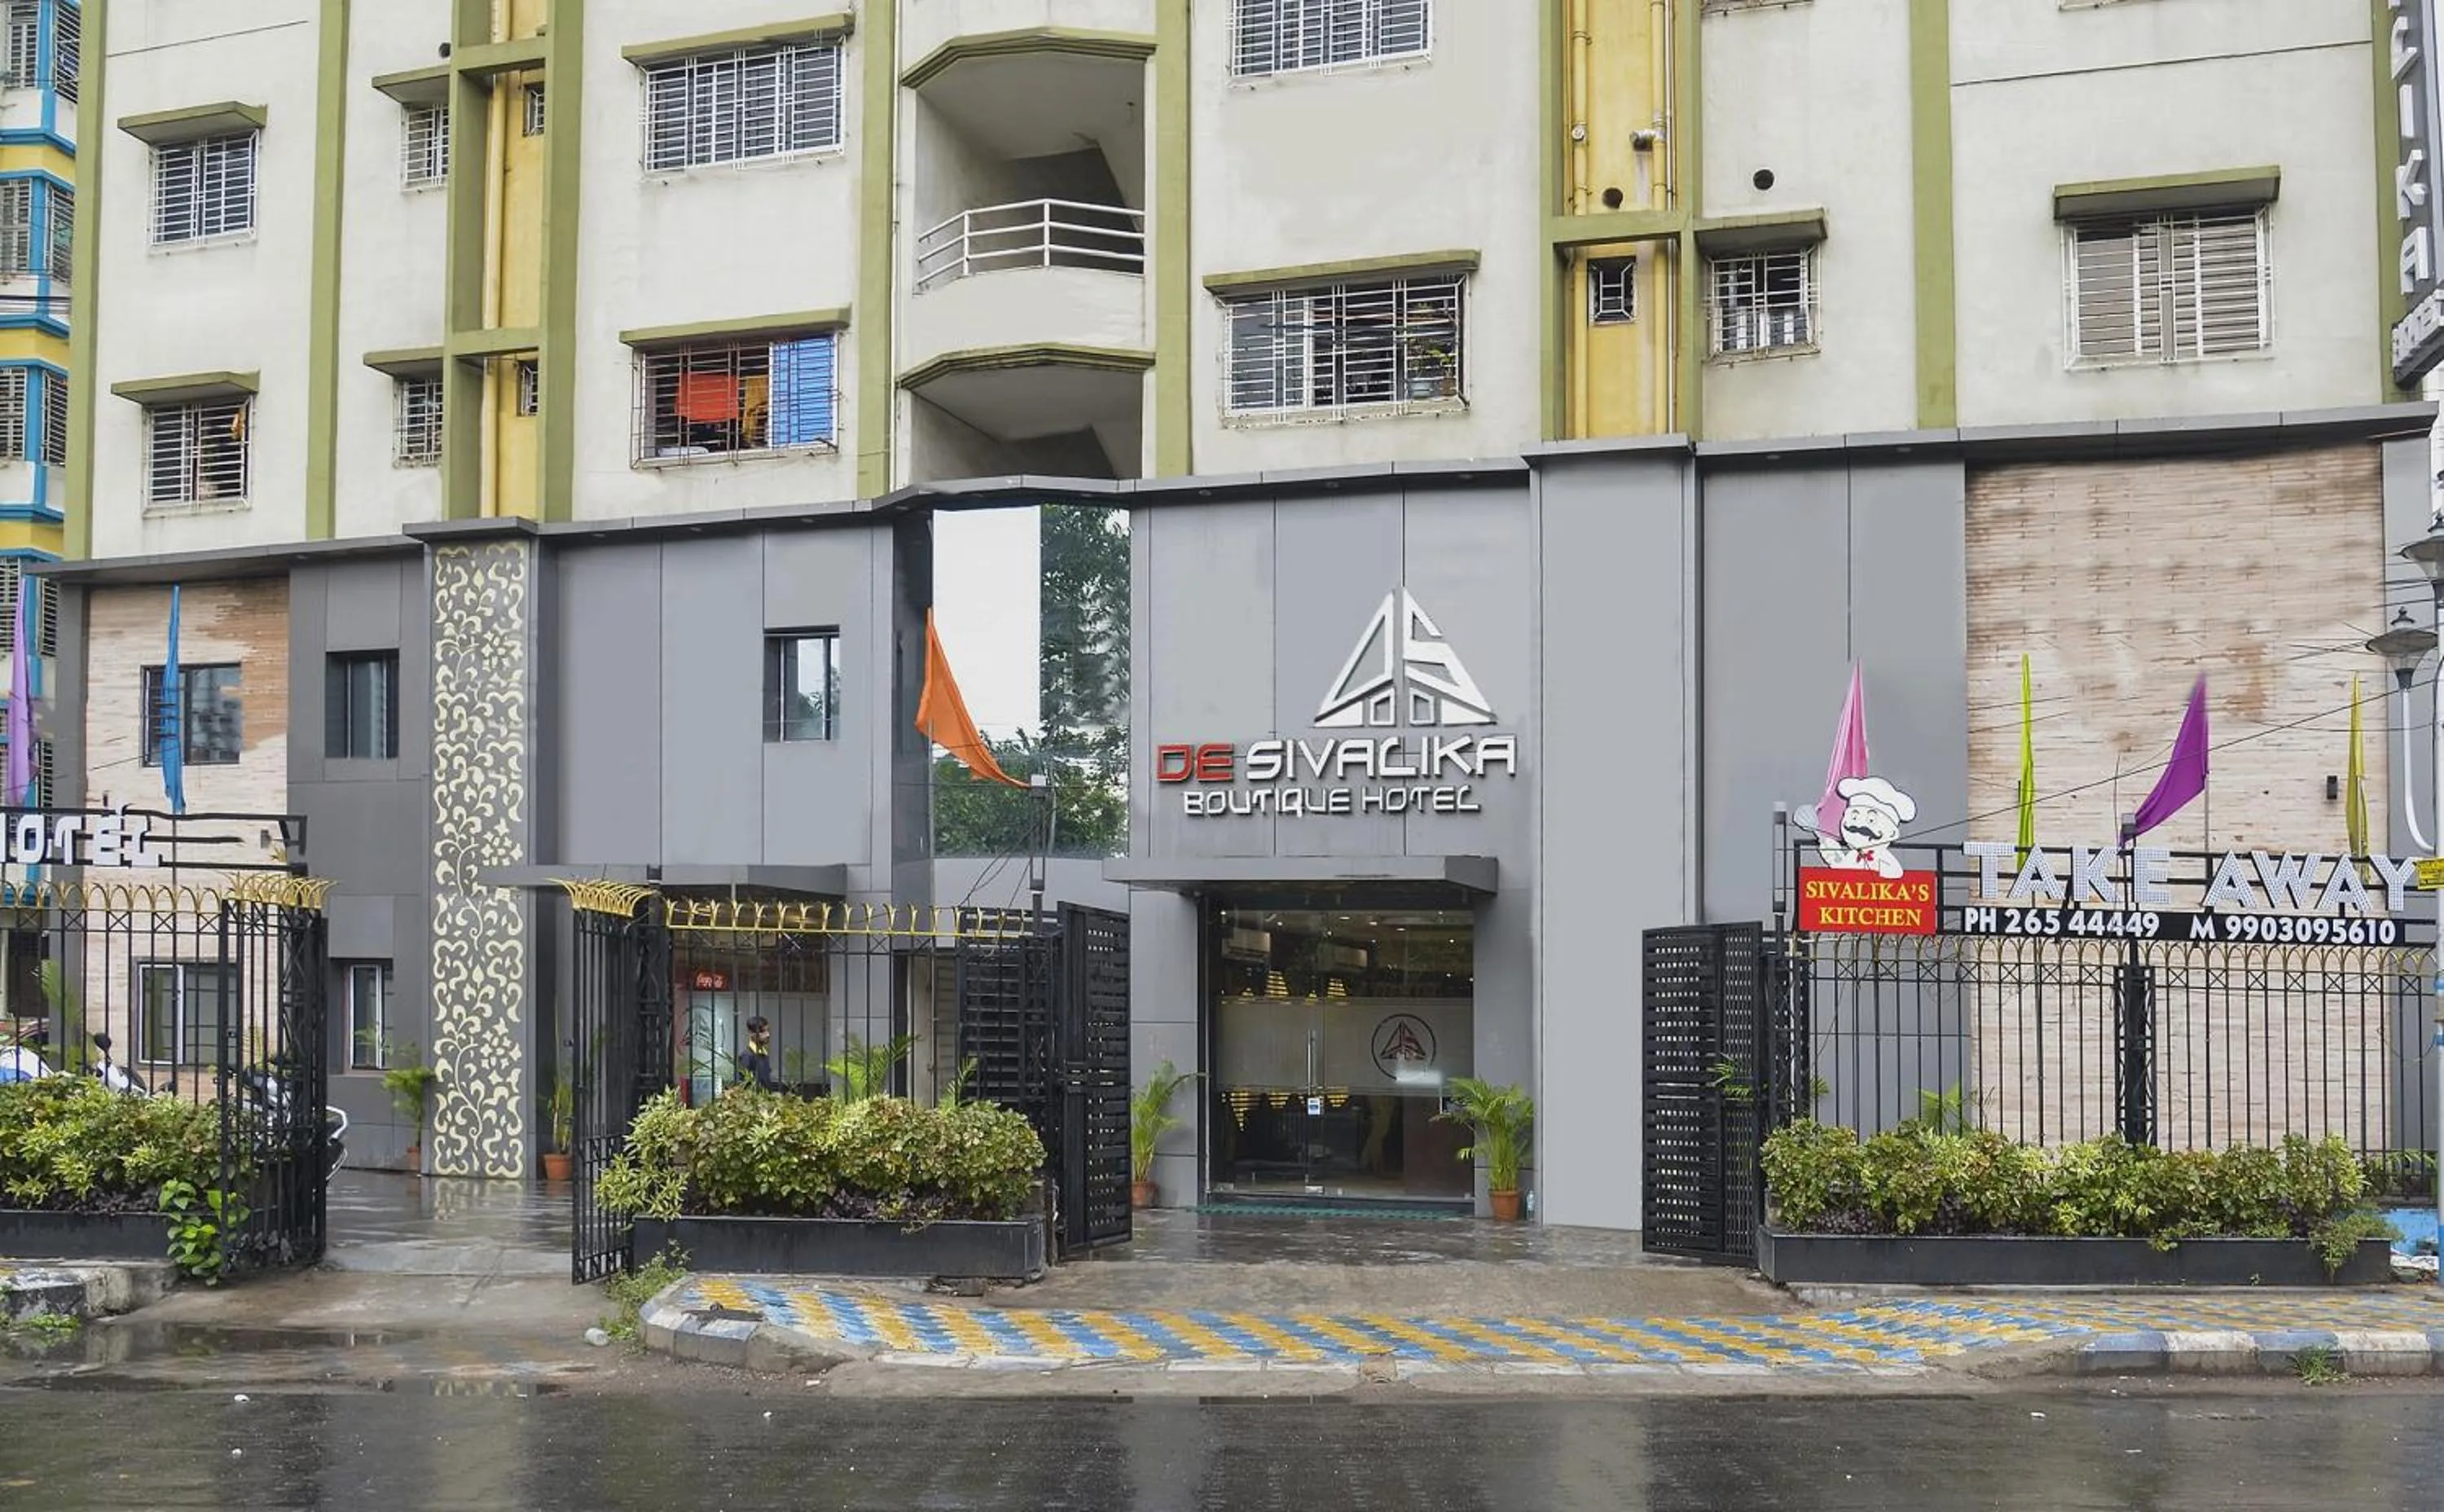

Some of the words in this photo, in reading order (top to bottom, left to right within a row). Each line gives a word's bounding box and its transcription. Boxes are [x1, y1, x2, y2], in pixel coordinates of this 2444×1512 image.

[2388, 0, 2429, 295] LIKA
[1157, 743, 1234, 781] DE
[1246, 735, 1516, 780] SIVALIKA
[1184, 787, 1352, 817] BOUTIQUE
[1362, 785, 1481, 813] HOTEL
[0, 812, 160, 867] OTEL
[1805, 881, 1930, 901] SIVALIKA'S
[1963, 841, 2170, 904] TAKE
[2202, 849, 2417, 912] AWAY
[1819, 906, 1923, 927] KITCHEN
[1964, 908, 1997, 934] PH
[2190, 916, 2217, 941] M
[2225, 917, 2396, 945] 9903095610
